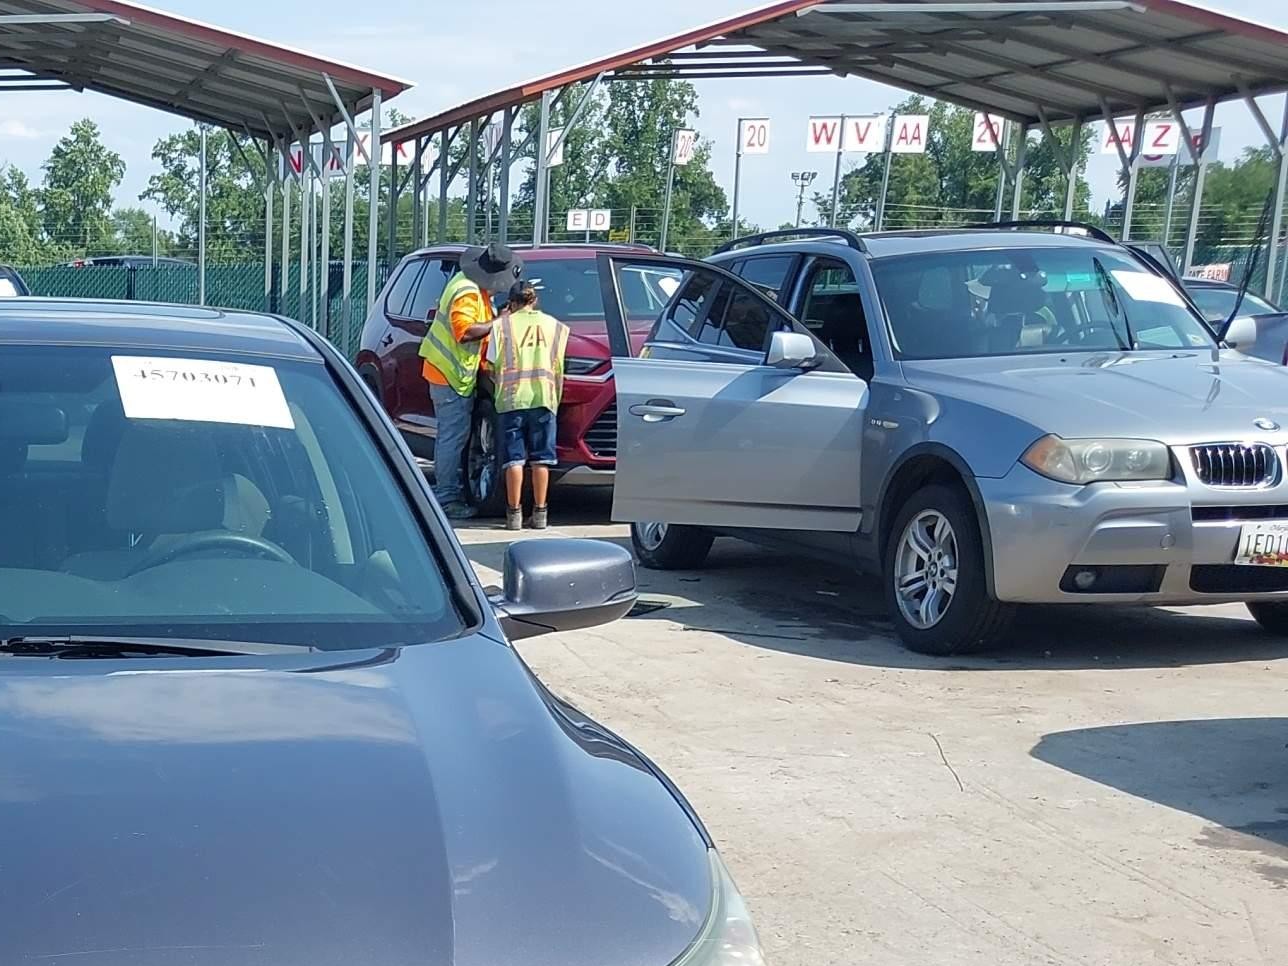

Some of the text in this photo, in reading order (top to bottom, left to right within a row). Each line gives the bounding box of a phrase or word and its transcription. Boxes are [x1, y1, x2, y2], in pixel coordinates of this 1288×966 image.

[746, 124, 766, 147] 20
[812, 122, 837, 145] W
[855, 122, 871, 144] V
[896, 125, 922, 146] AA
[1152, 125, 1171, 147] Z
[573, 213, 582, 226] E
[595, 213, 605, 226] D
